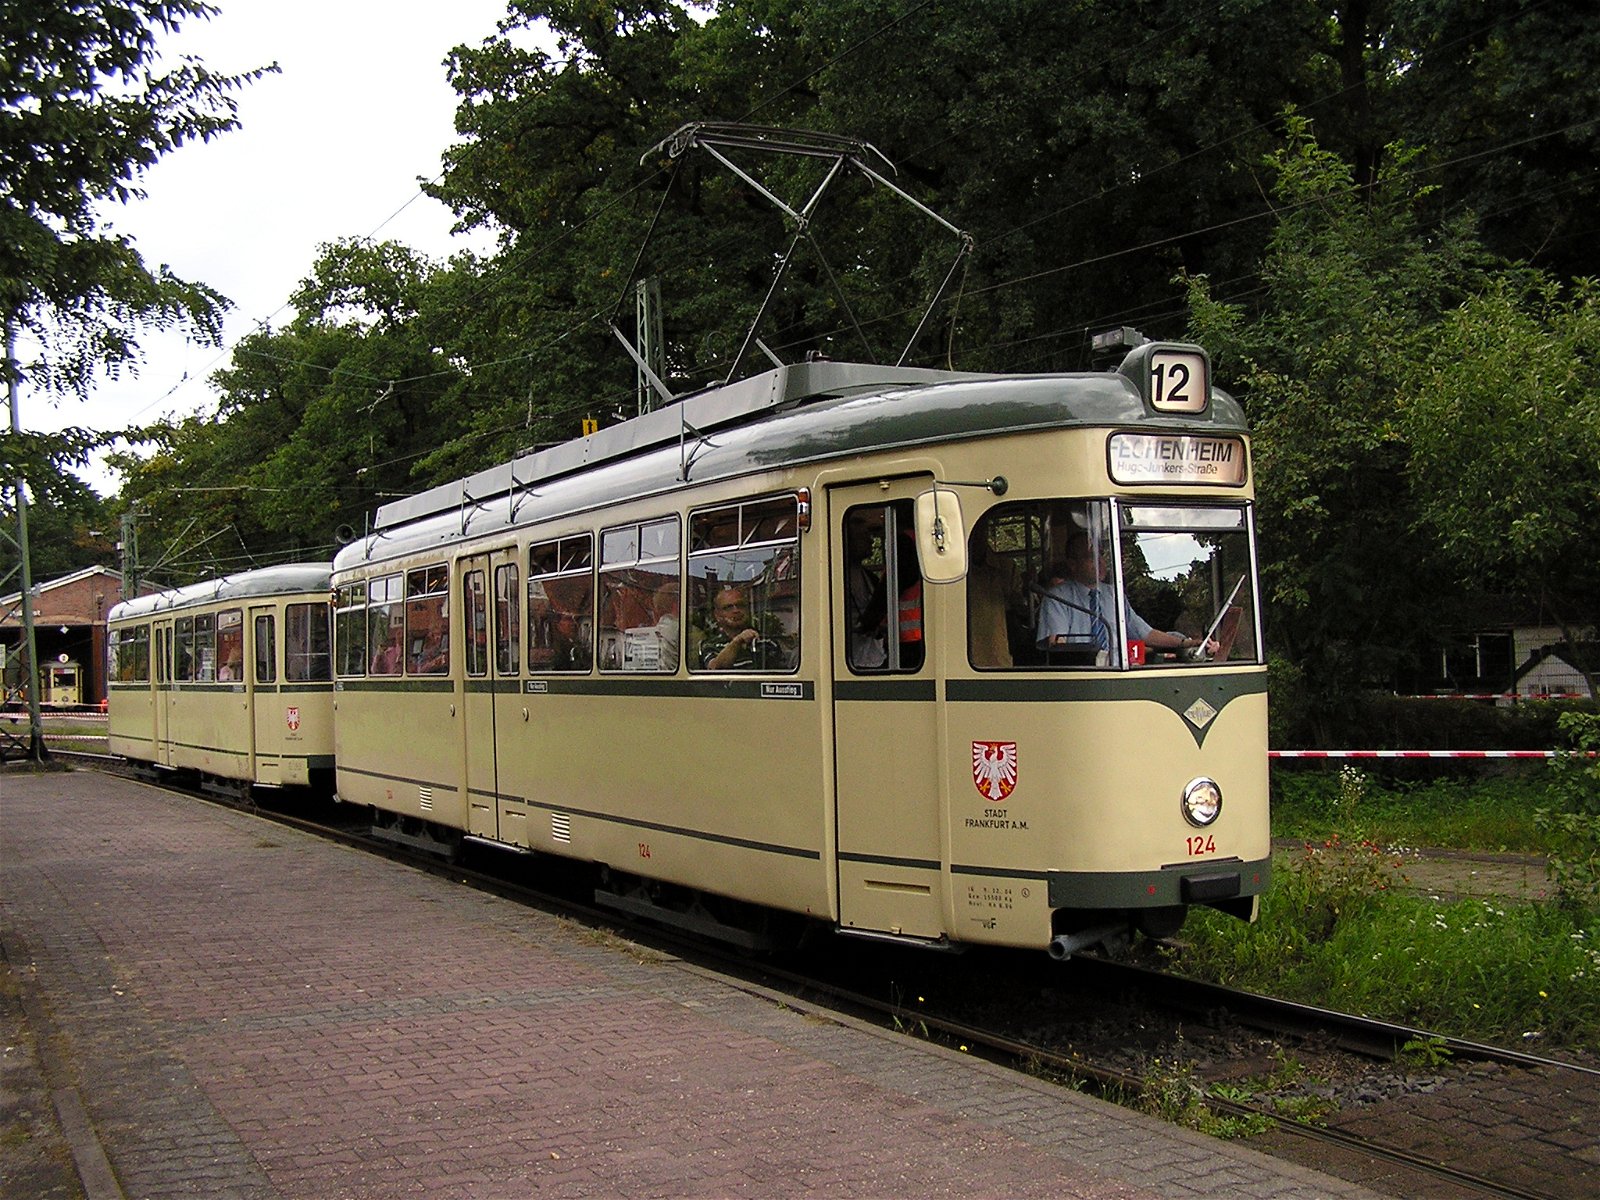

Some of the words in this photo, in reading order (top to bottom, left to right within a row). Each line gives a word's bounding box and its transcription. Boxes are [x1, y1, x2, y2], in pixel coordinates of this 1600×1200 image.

[1151, 363, 1190, 402] 12
[984, 808, 1008, 818] STADT
[964, 818, 1010, 830] FRANKFURT
[638, 842, 651, 859] 124
[1186, 834, 1216, 856] 124
